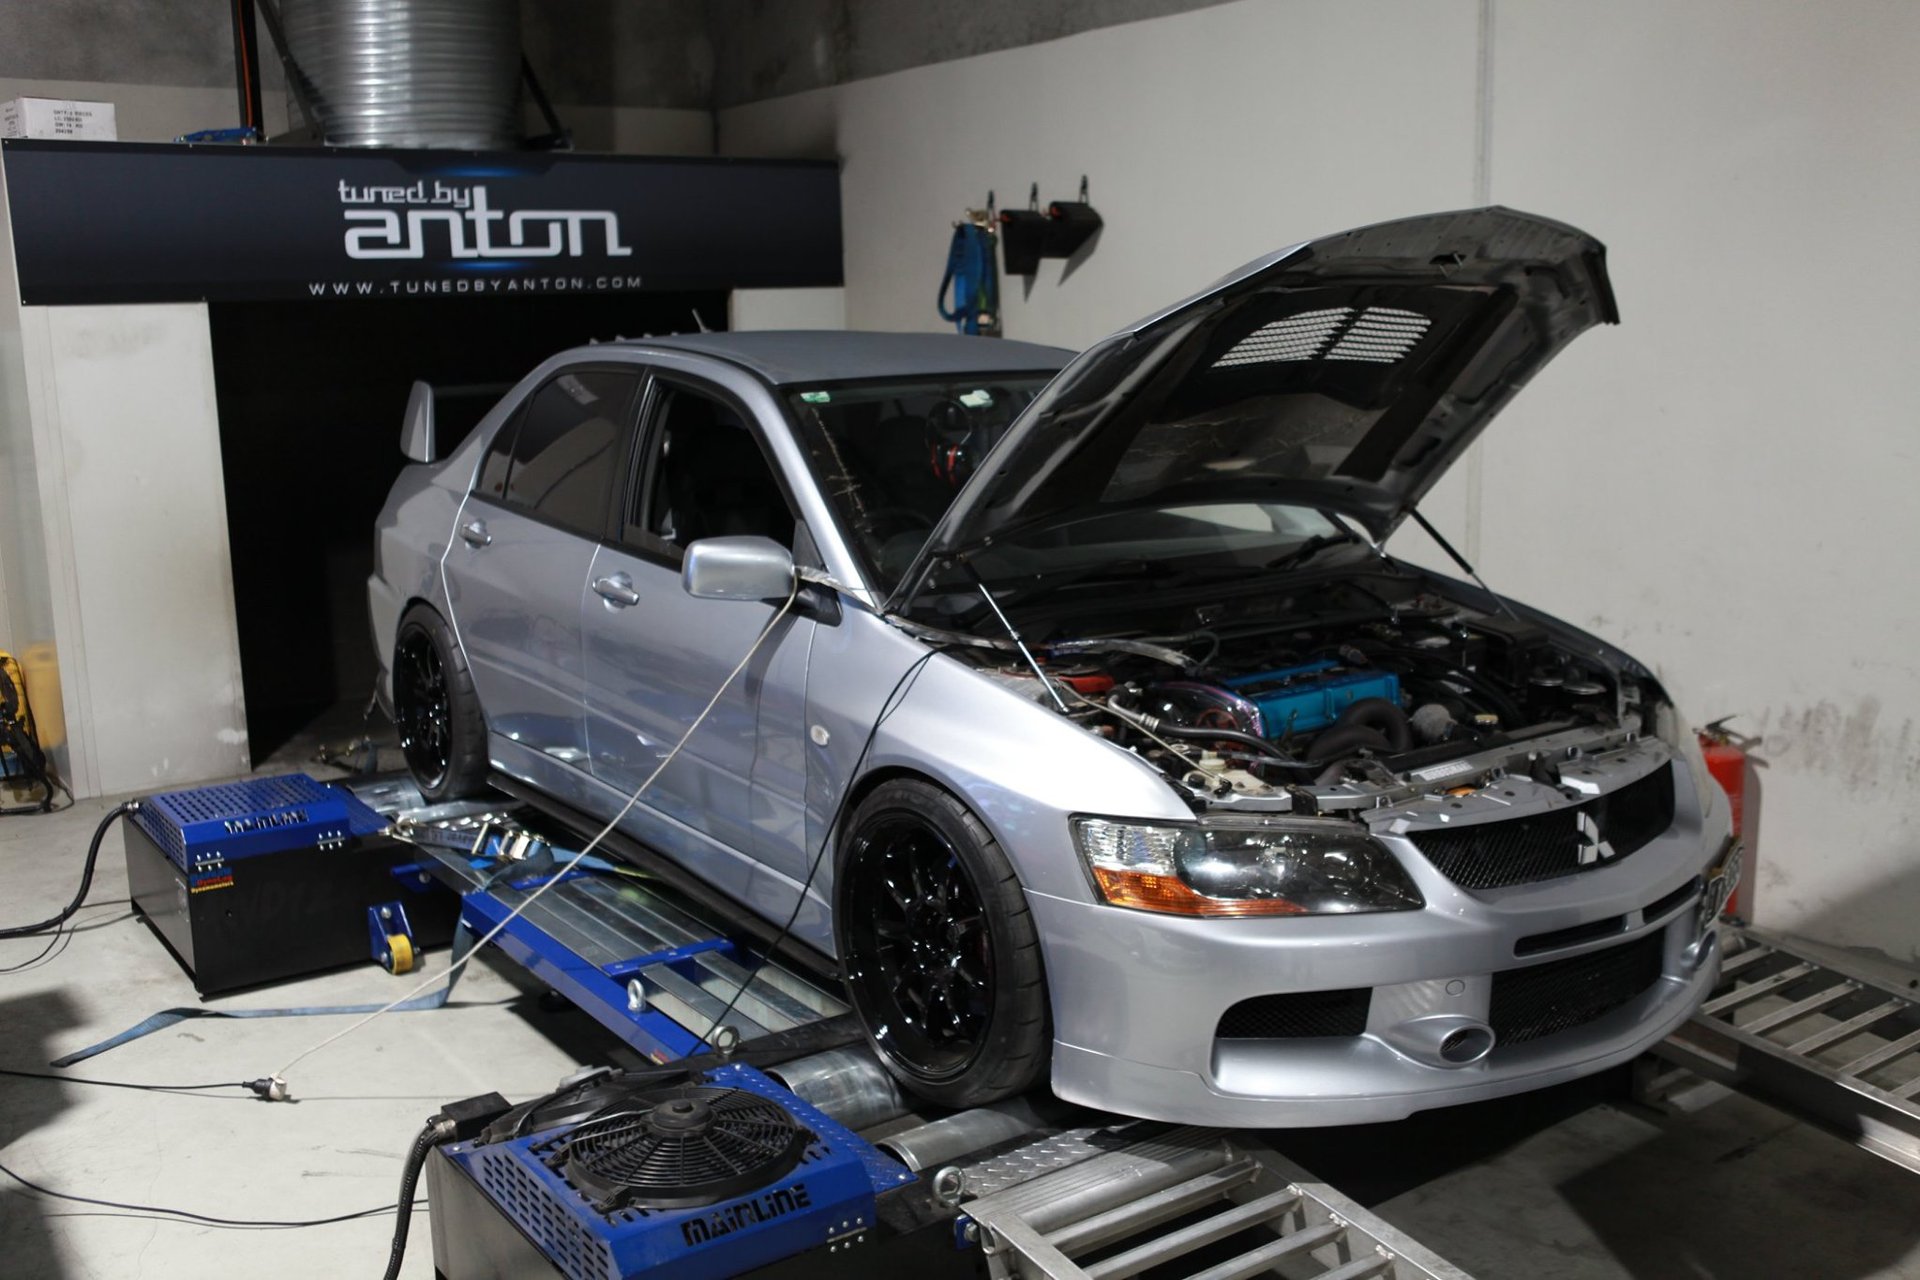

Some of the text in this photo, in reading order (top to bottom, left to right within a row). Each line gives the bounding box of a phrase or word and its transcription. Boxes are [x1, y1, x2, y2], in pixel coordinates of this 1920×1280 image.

[338, 179, 470, 208] tuned by
[344, 186, 632, 259] anton
[309, 276, 642, 296] WWW.TUNEDBYANTON.COM
